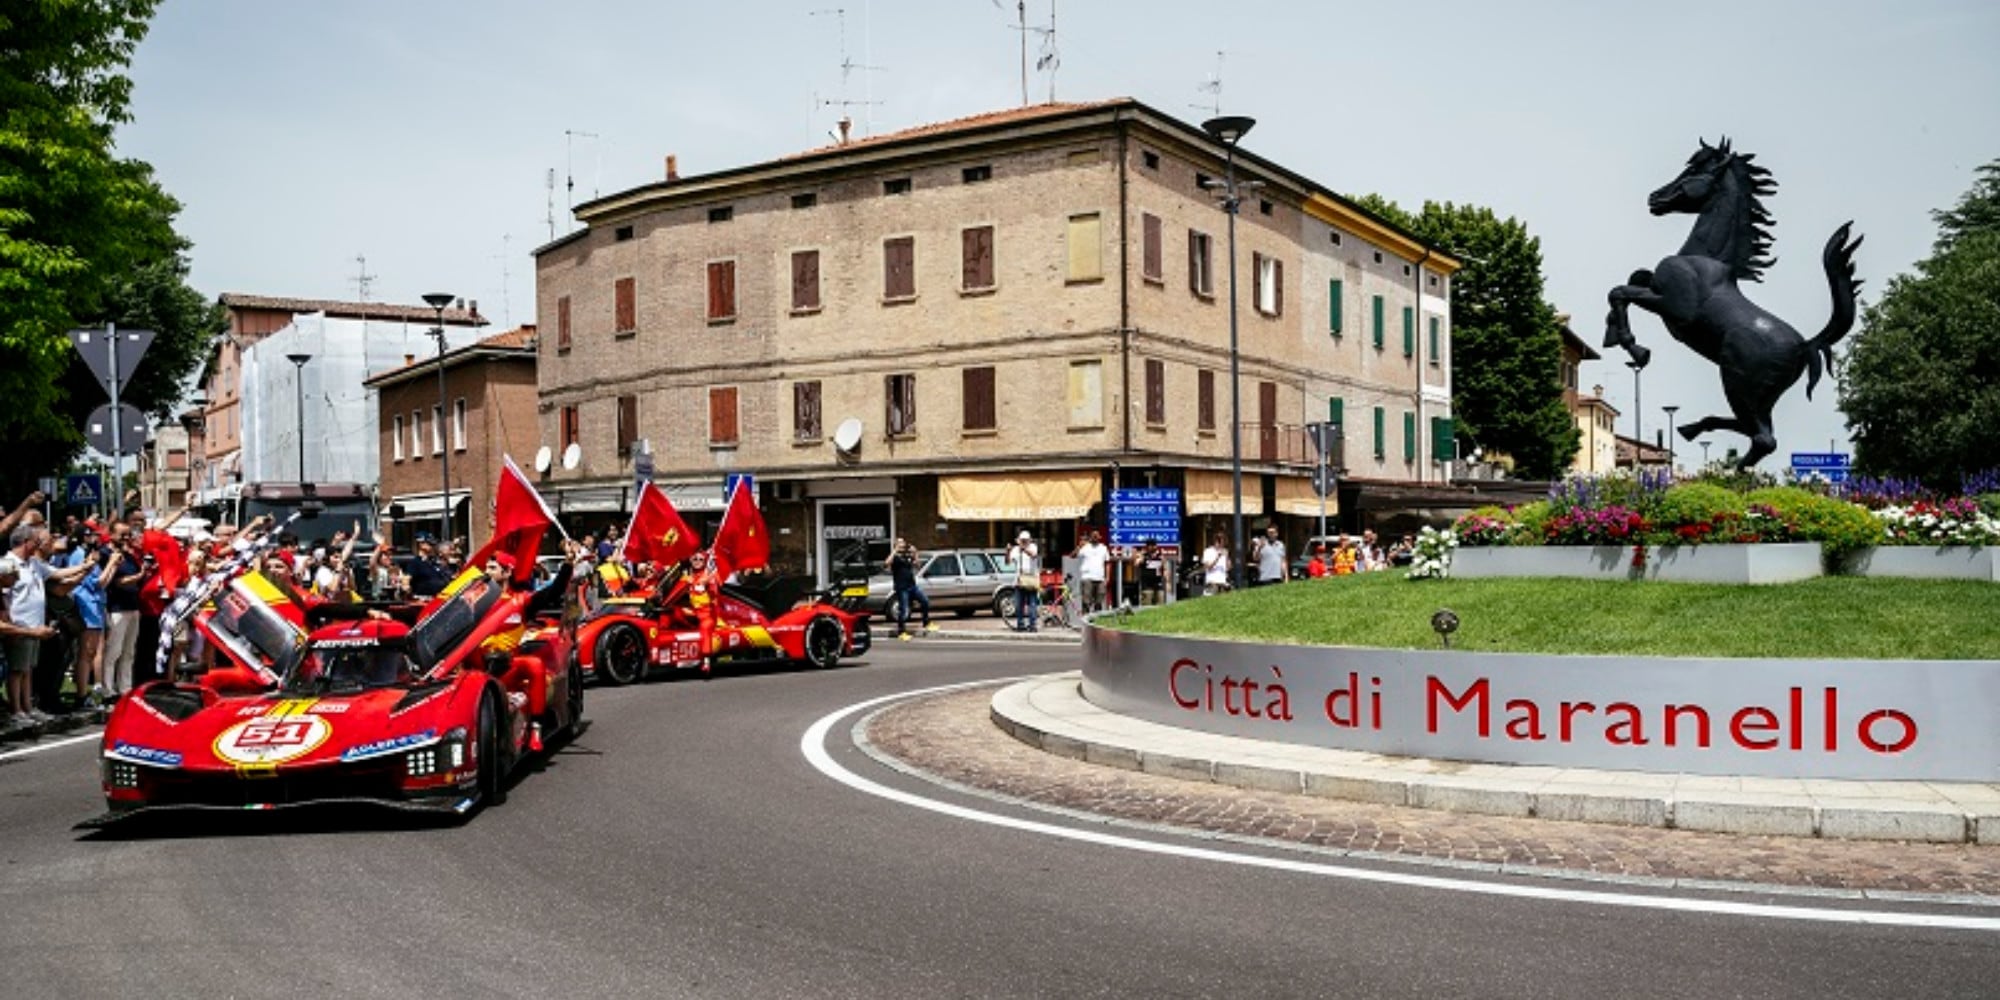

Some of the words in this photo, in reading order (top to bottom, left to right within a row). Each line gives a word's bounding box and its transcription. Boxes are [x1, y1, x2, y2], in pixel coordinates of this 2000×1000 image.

[239, 724, 305, 744] 51
[1168, 657, 1293, 722] Città
[1324, 671, 1383, 730] di
[1426, 674, 1920, 754] Maranello
